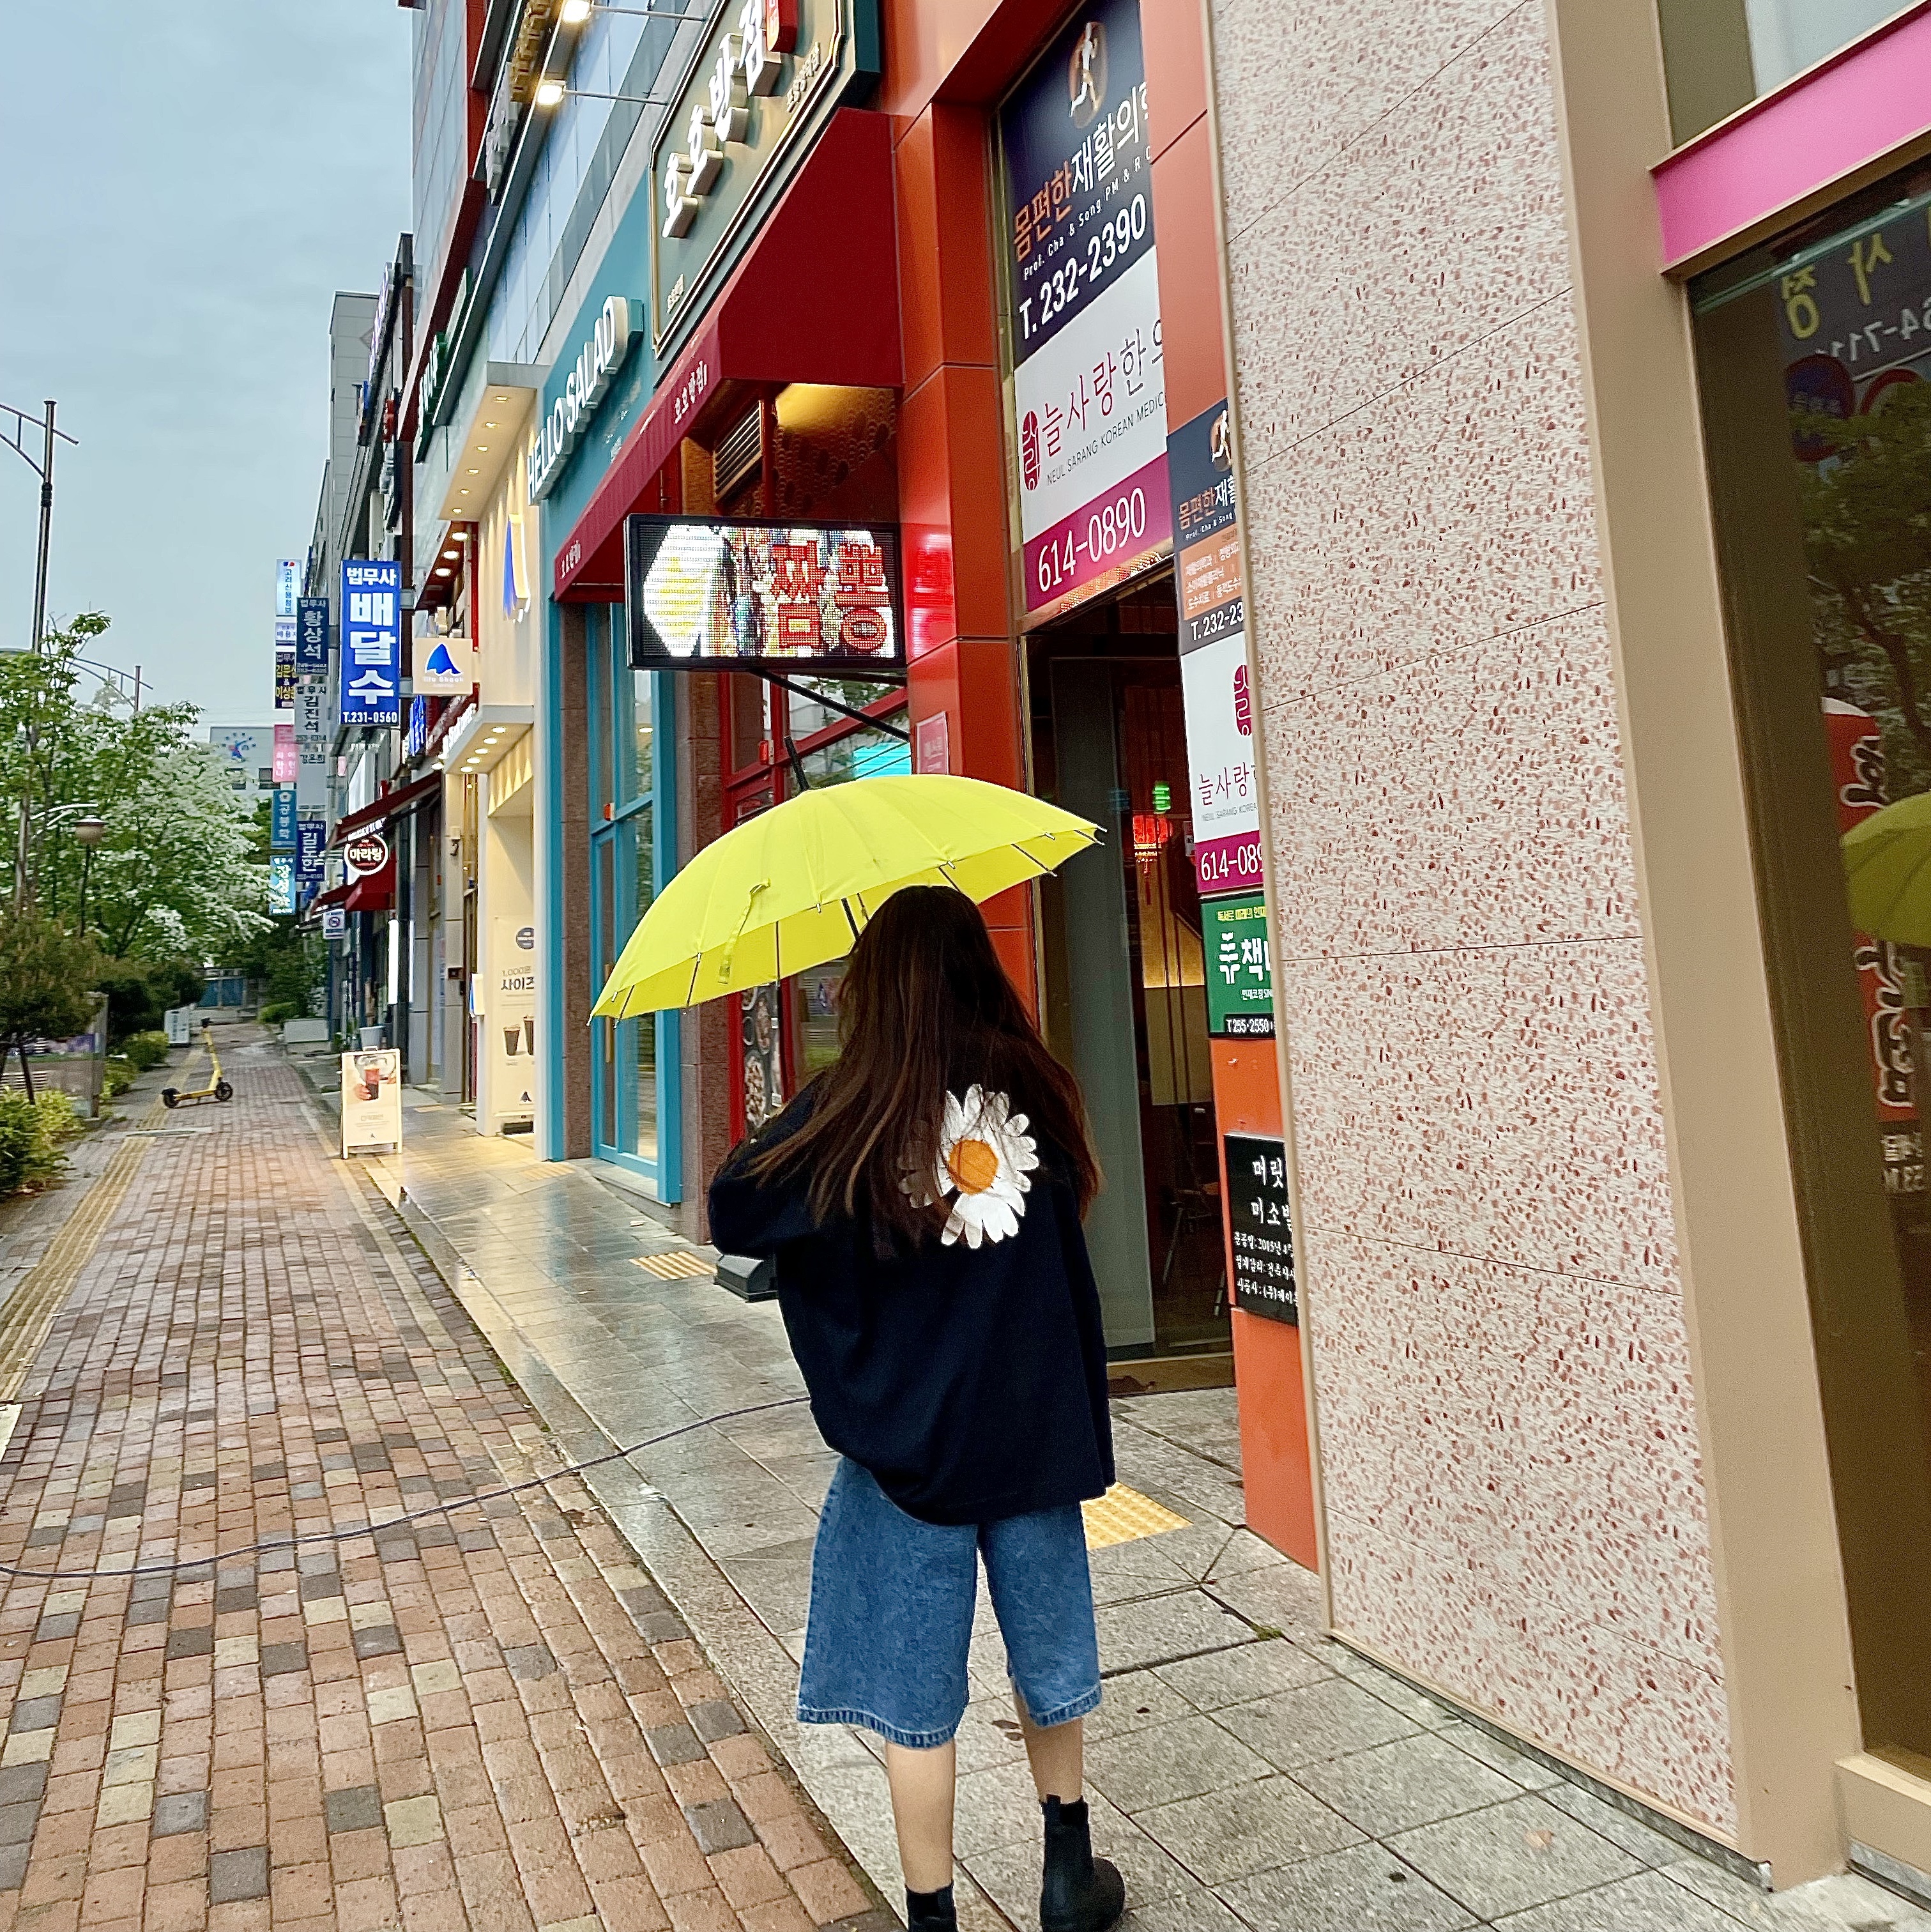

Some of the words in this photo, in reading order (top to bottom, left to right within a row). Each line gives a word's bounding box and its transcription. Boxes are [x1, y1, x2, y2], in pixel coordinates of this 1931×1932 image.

[662, 0, 763, 238] 호호반점
[1023, 259, 1045, 280] Prof.
[1048, 236, 1064, 257] Cha
[1069, 223, 1076, 236] &
[1080, 199, 1102, 227] Song
[1104, 178, 1119, 202] PM
[1122, 167, 1130, 183] &
[1134, 156, 1141, 173] R
[527, 397, 565, 505] HELLO
[566, 295, 617, 433] SALAD
[673, 360, 708, 424] 호호반점
[1047, 464, 1065, 486] NEUL
[1067, 440, 1099, 472] SARANG
[1101, 414, 1134, 448] KOREAN
[1037, 487, 1146, 592] 614-0890
[300, 599, 326, 608] 법무사
[346, 567, 397, 586] 법무사
[771, 540, 890, 652] 짬뽕
[303, 610, 324, 659] 황상석
[348, 592, 397, 705] 배달수
[342, 711, 397, 723] T.231-0560
[1198, 762, 1255, 806] 늘사랑
